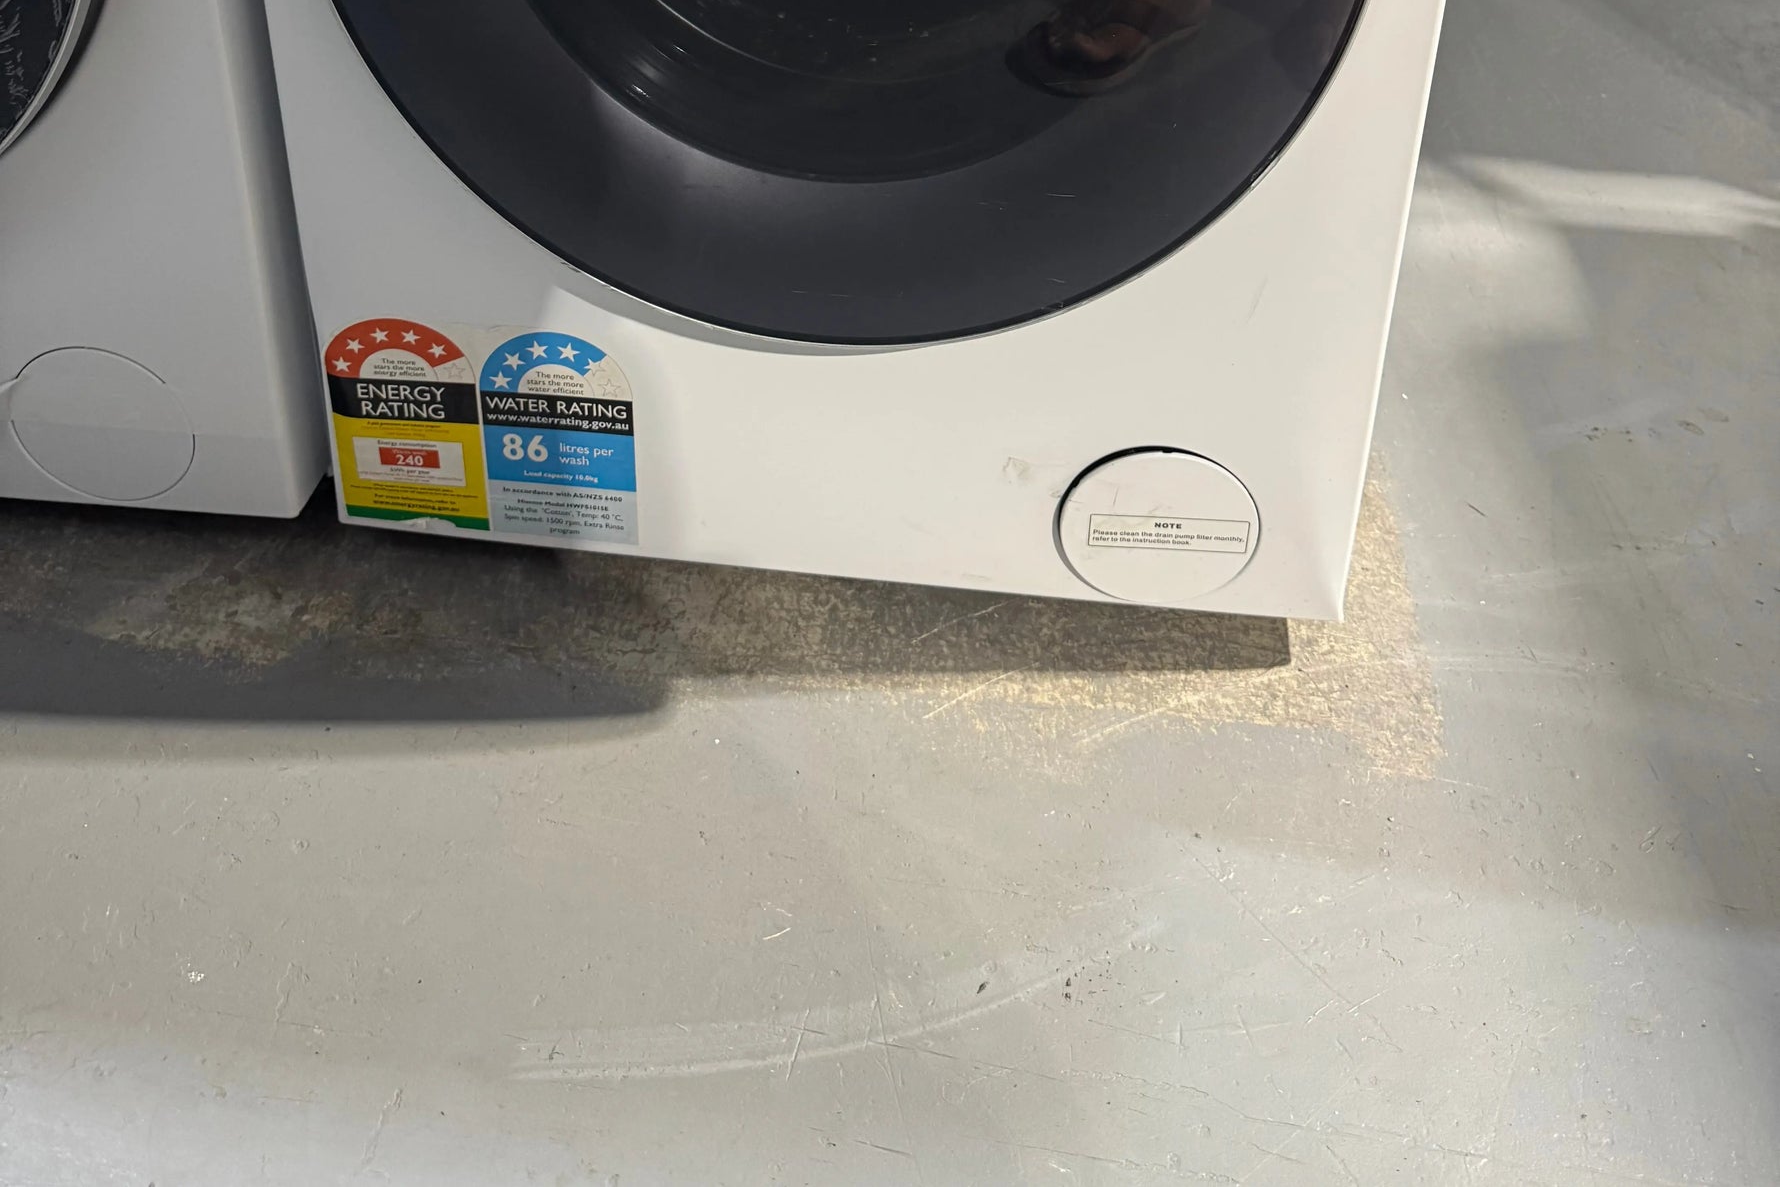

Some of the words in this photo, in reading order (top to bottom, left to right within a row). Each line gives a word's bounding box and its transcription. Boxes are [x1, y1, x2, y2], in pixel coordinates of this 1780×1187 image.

[374, 370, 398, 378] energy
[356, 382, 446, 402] ENERGY
[528, 386, 551, 394] water
[553, 387, 584, 396] efficient
[360, 400, 446, 419] RATING
[486, 396, 550, 412] WATER
[556, 400, 627, 419] RATING
[486, 414, 630, 430] www.waterrating.gov.au
[502, 433, 549, 463] 86
[560, 442, 590, 455] litres
[593, 447, 614, 458] per
[396, 454, 424, 466] 240
[559, 456, 590, 466] wash
[544, 472, 573, 480] capacity
[512, 487, 554, 496] accordance
[1092, 528, 1118, 536] Please
[1132, 537, 1171, 545] instruction
[1172, 538, 1192, 546] book.
